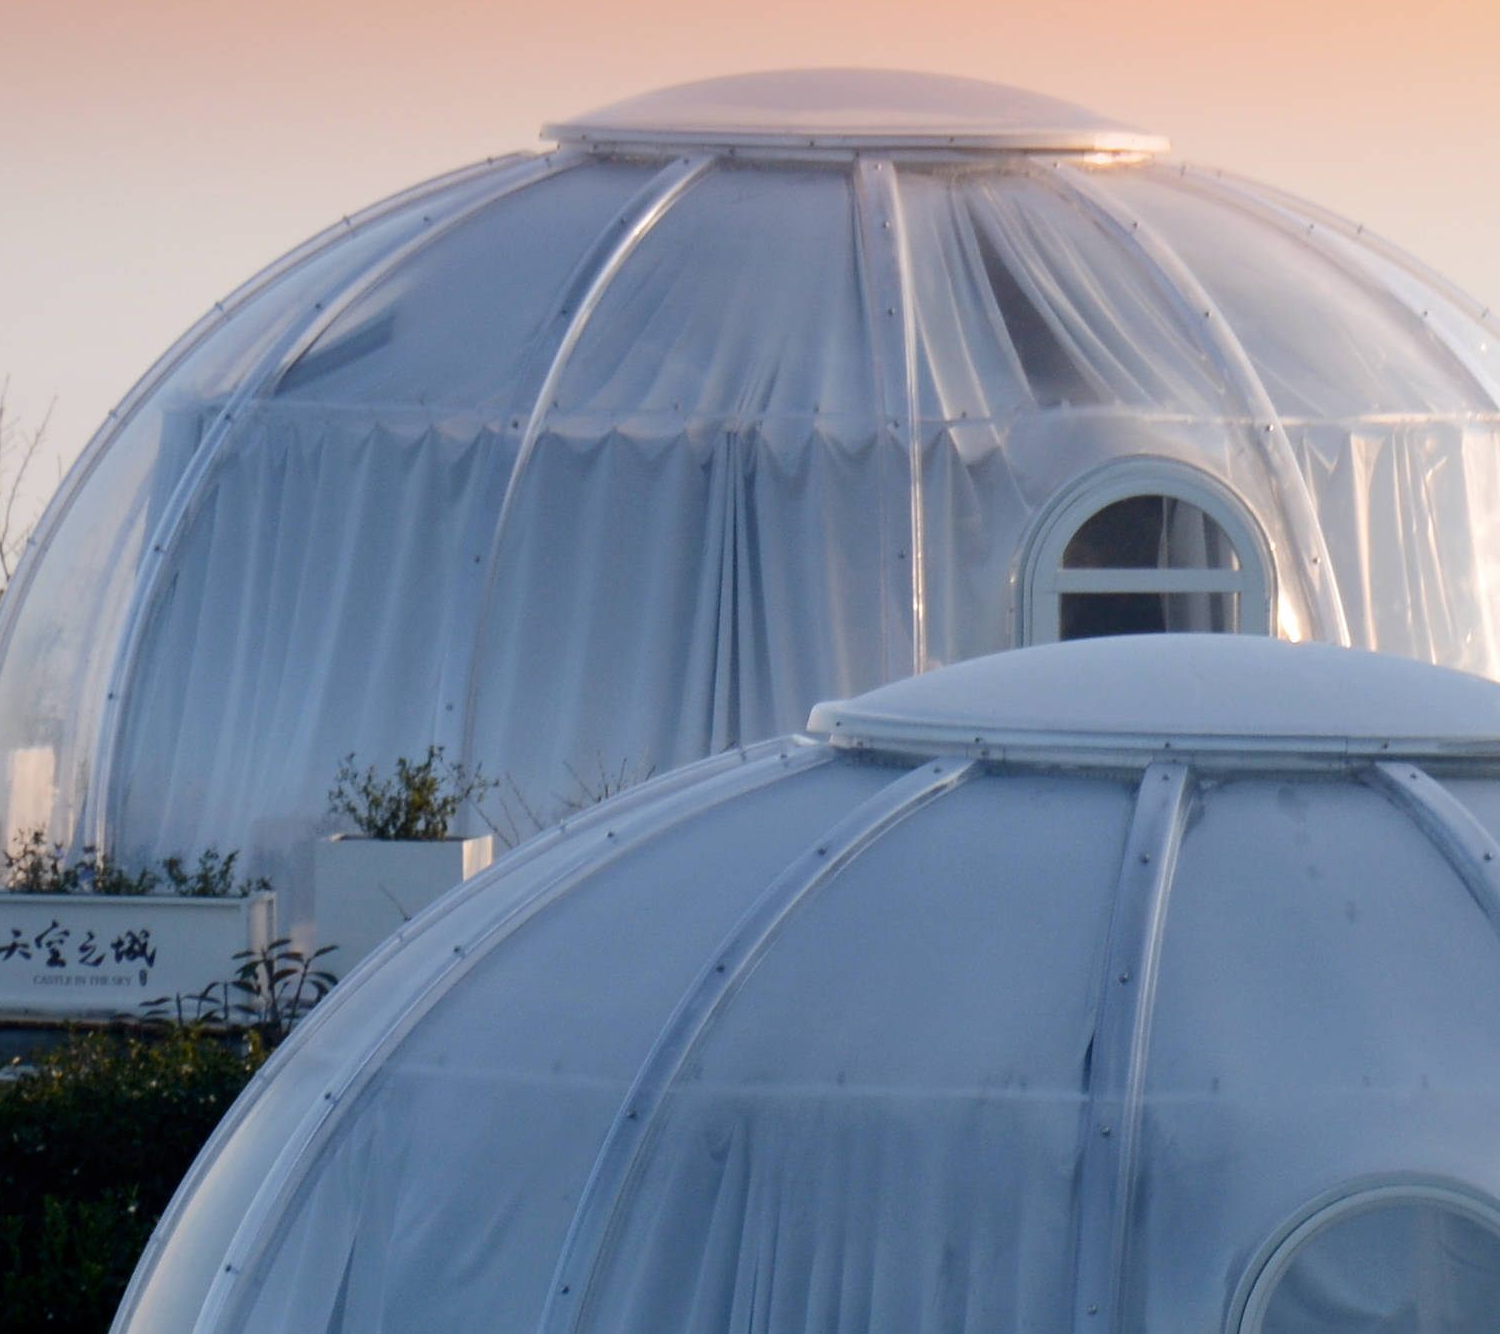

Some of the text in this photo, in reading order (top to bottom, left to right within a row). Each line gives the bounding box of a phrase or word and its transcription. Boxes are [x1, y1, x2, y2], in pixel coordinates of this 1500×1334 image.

[33, 974, 72, 986] CASTLE
[75, 974, 86, 986] IN
[90, 974, 109, 986] THE
[112, 974, 133, 986] SKY
